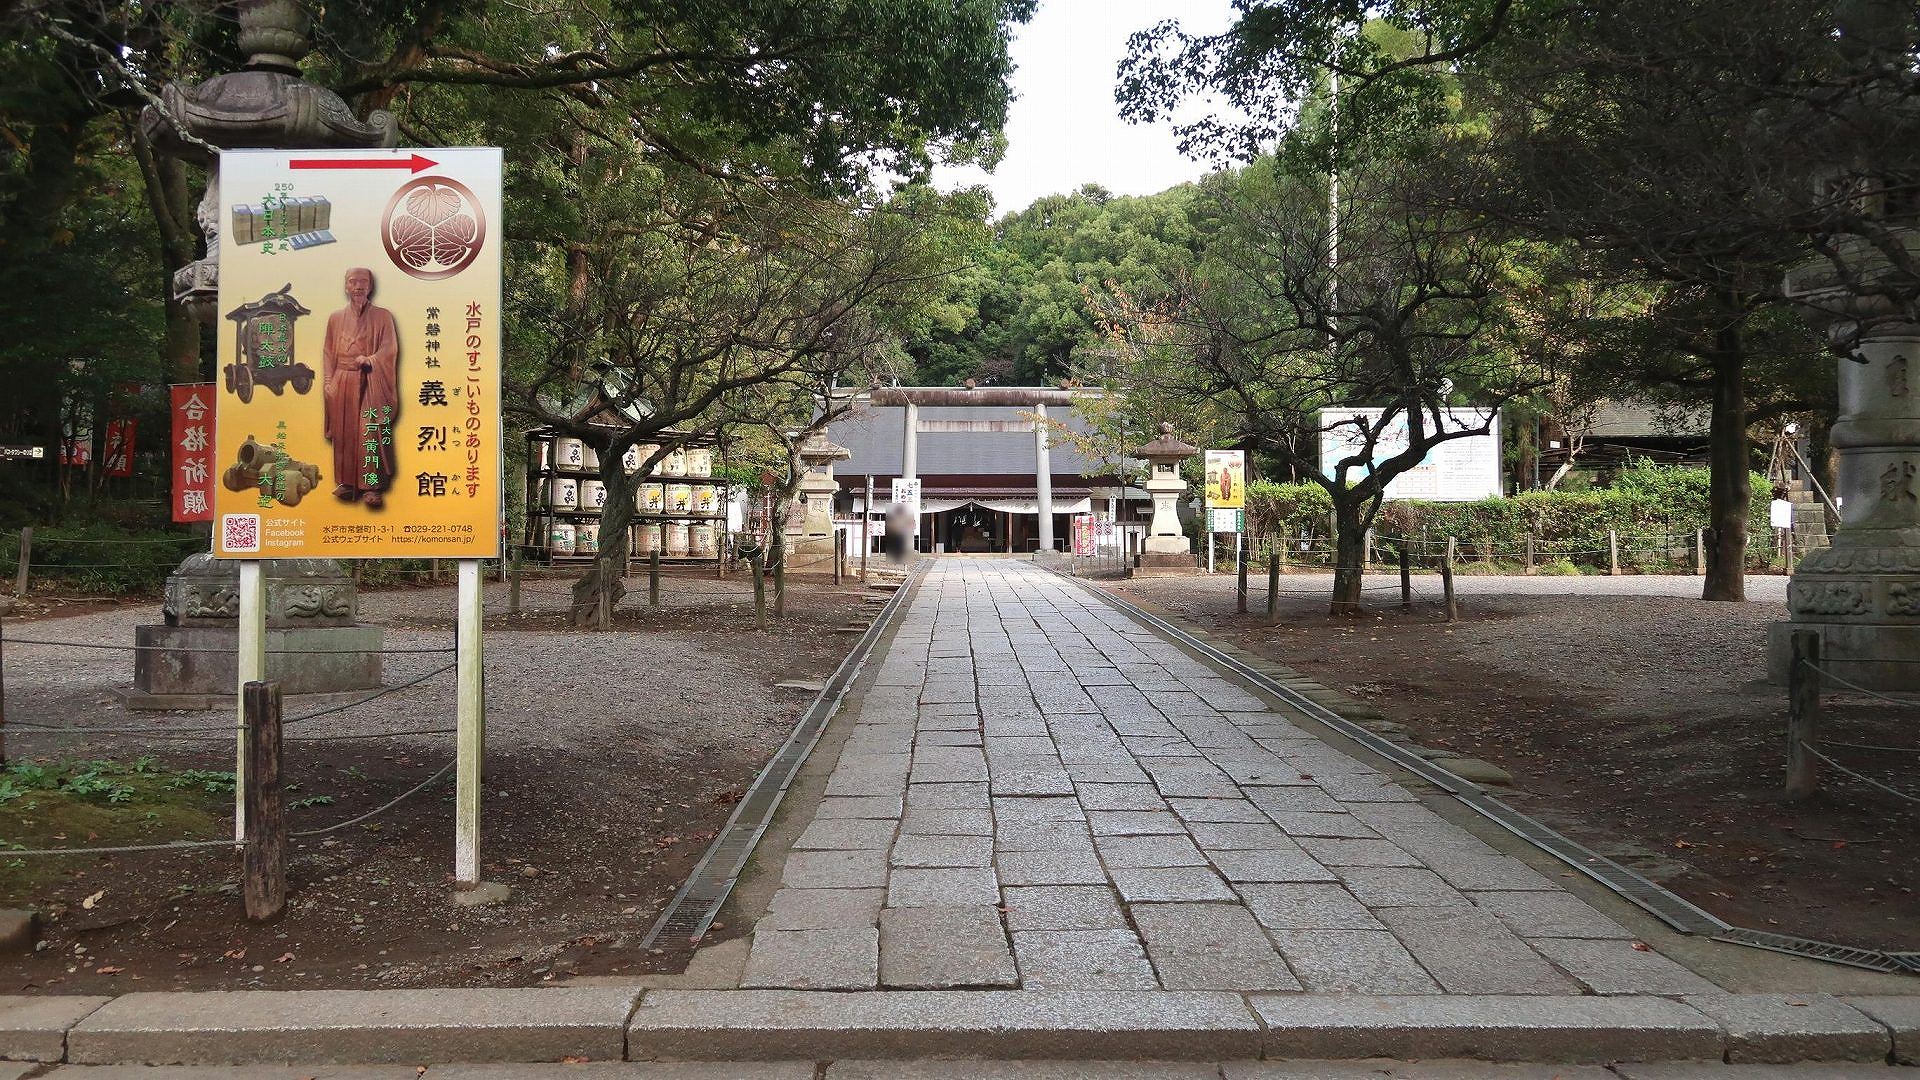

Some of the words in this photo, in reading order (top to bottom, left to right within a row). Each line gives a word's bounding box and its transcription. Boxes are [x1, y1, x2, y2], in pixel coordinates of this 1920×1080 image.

[274, 183, 294, 191] 250
[260, 193, 277, 255] 大日本史
[415, 380, 448, 498] 義烈館
[362, 407, 380, 486] 水戸黄門像
[265, 518, 306, 527] 公式サイト
[265, 528, 305, 537] Facebook
[265, 538, 304, 548] Instagram
[322, 535, 384, 543] 公式ウェブサイト
[391, 535, 476, 544] https://komonsan.jp/
